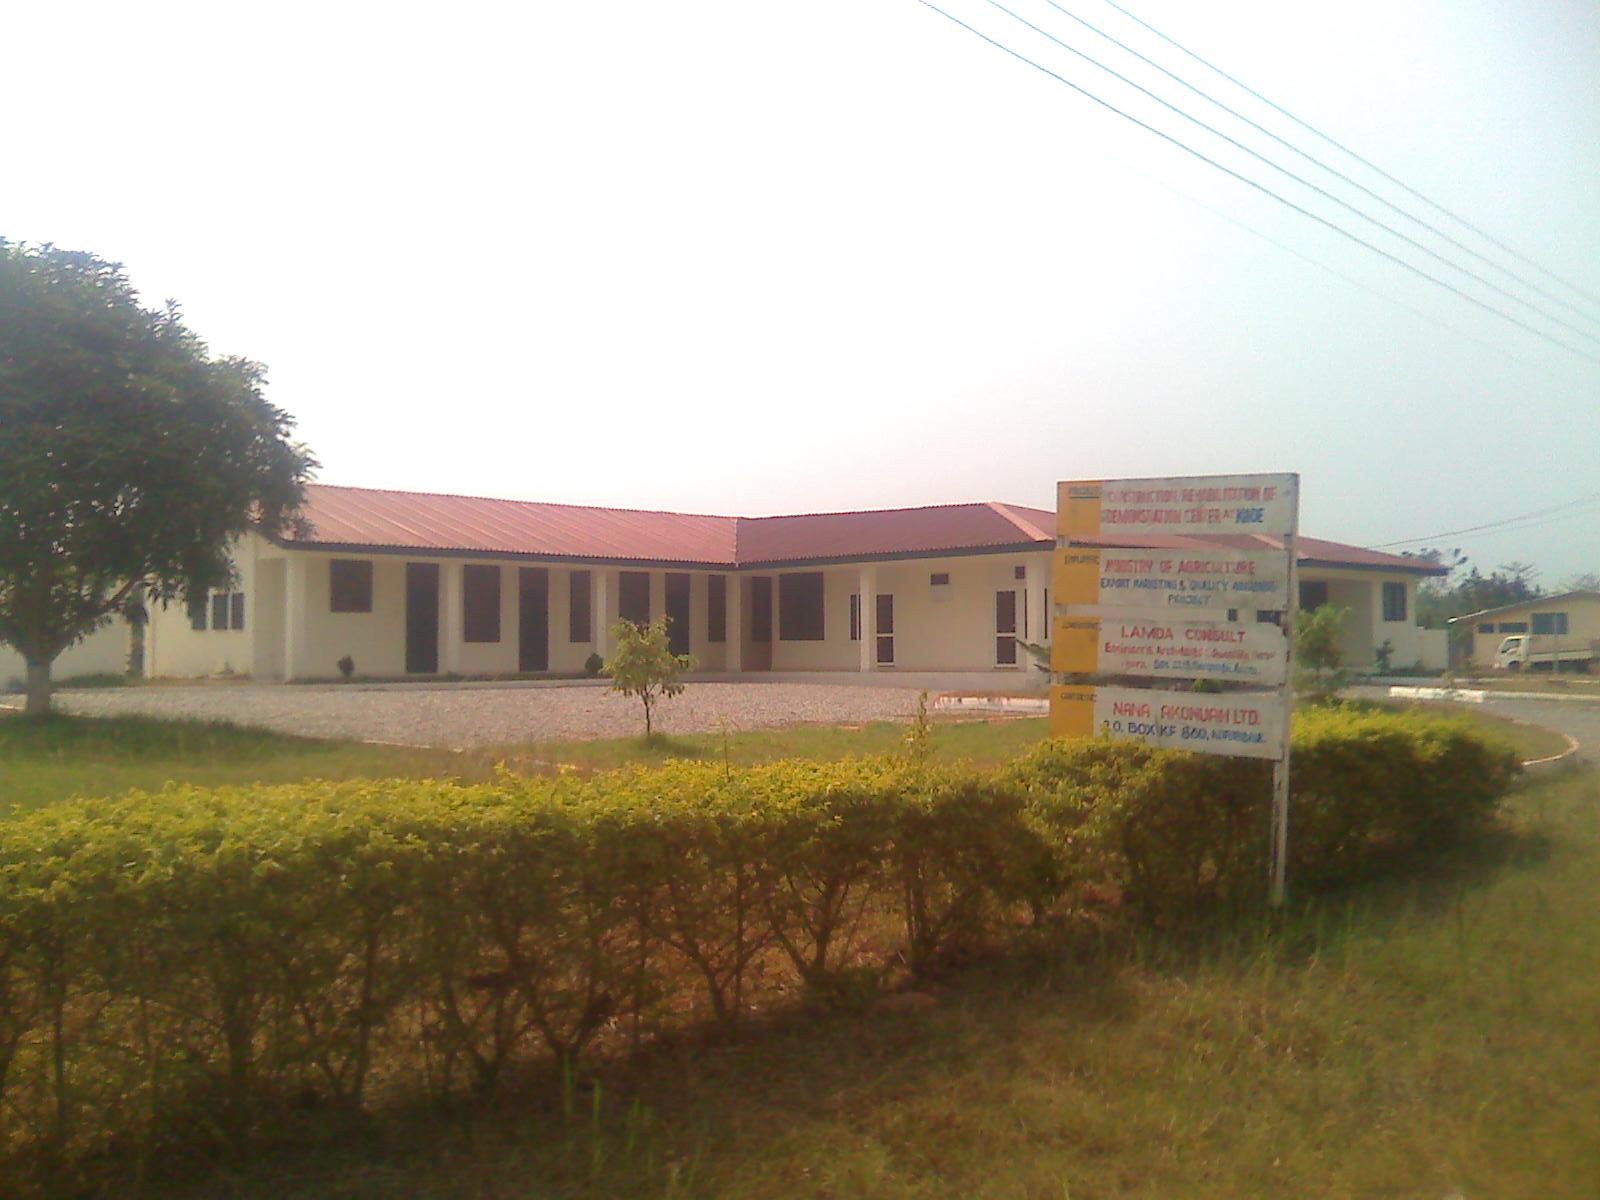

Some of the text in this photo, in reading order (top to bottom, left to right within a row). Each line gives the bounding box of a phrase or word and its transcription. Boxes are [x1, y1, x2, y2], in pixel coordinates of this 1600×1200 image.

[1105, 559, 1256, 575] MINISTRY OF AGRICULTURE
[1121, 625, 1246, 643] LAMDA CONSULT
[1113, 701, 1151, 718] NANA
[1128, 721, 1156, 735] BOX
[1160, 724, 1177, 737] KF
